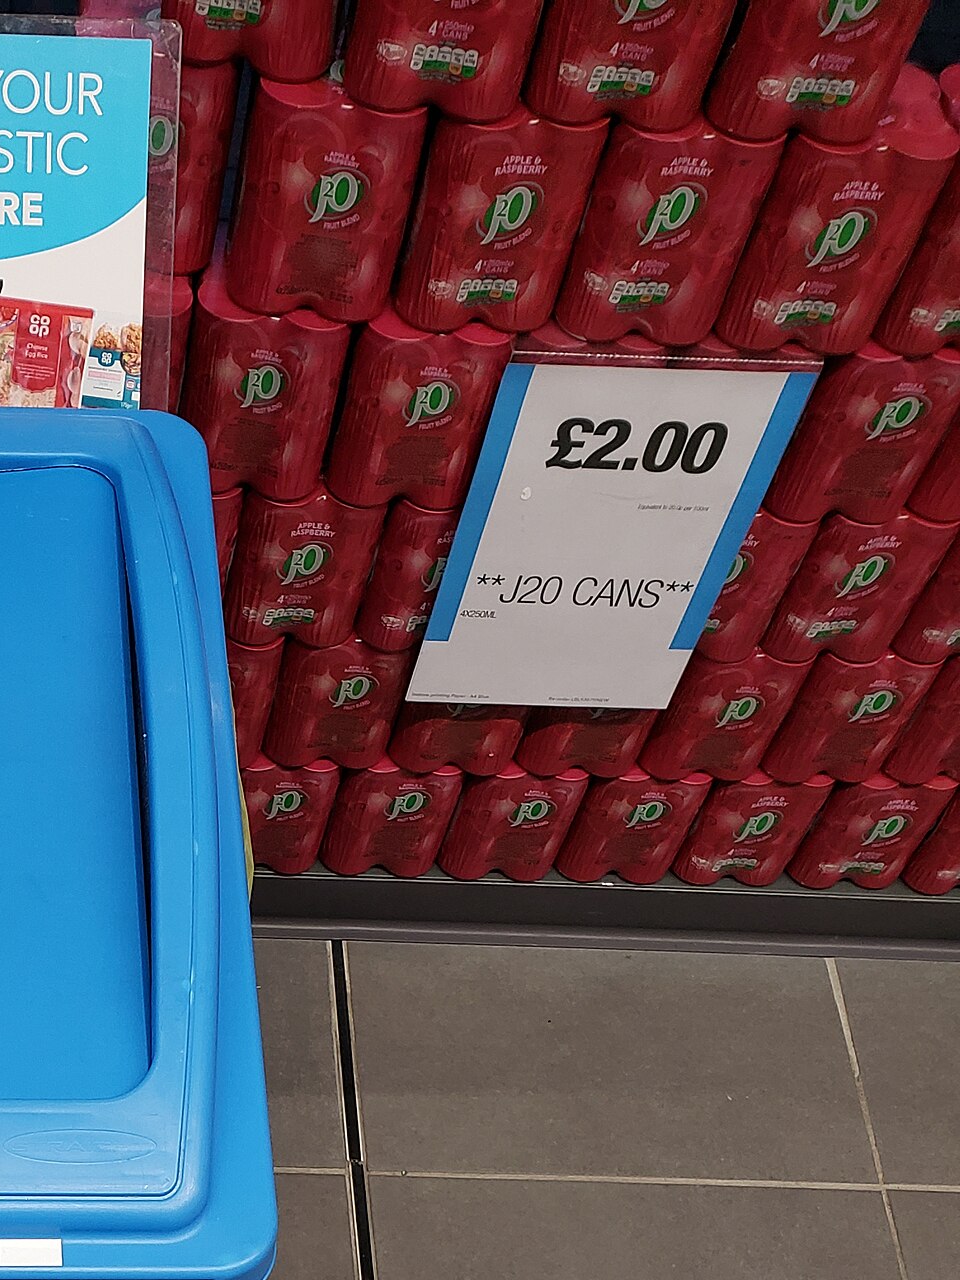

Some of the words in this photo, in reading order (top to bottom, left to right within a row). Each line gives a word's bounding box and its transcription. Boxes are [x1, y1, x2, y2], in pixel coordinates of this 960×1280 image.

[429, 20, 438, 36] 4
[610, 42, 620, 57] 4
[503, 155, 533, 165] APPLE
[670, 156, 698, 167] APPLE
[495, 164, 548, 176] RASPBERRY
[660, 166, 714, 177] RASPBERRY
[843, 180, 870, 190] APPLE
[832, 189, 886, 201] RASPBERRY
[474, 260, 482, 272] 4
[631, 260, 640, 274] 4
[545, 417, 729, 474] £2.00
[291, 528, 336, 538] RASPBERRY
[277, 595, 285, 603] 4
[460, 610, 497, 619] 4X250ML
